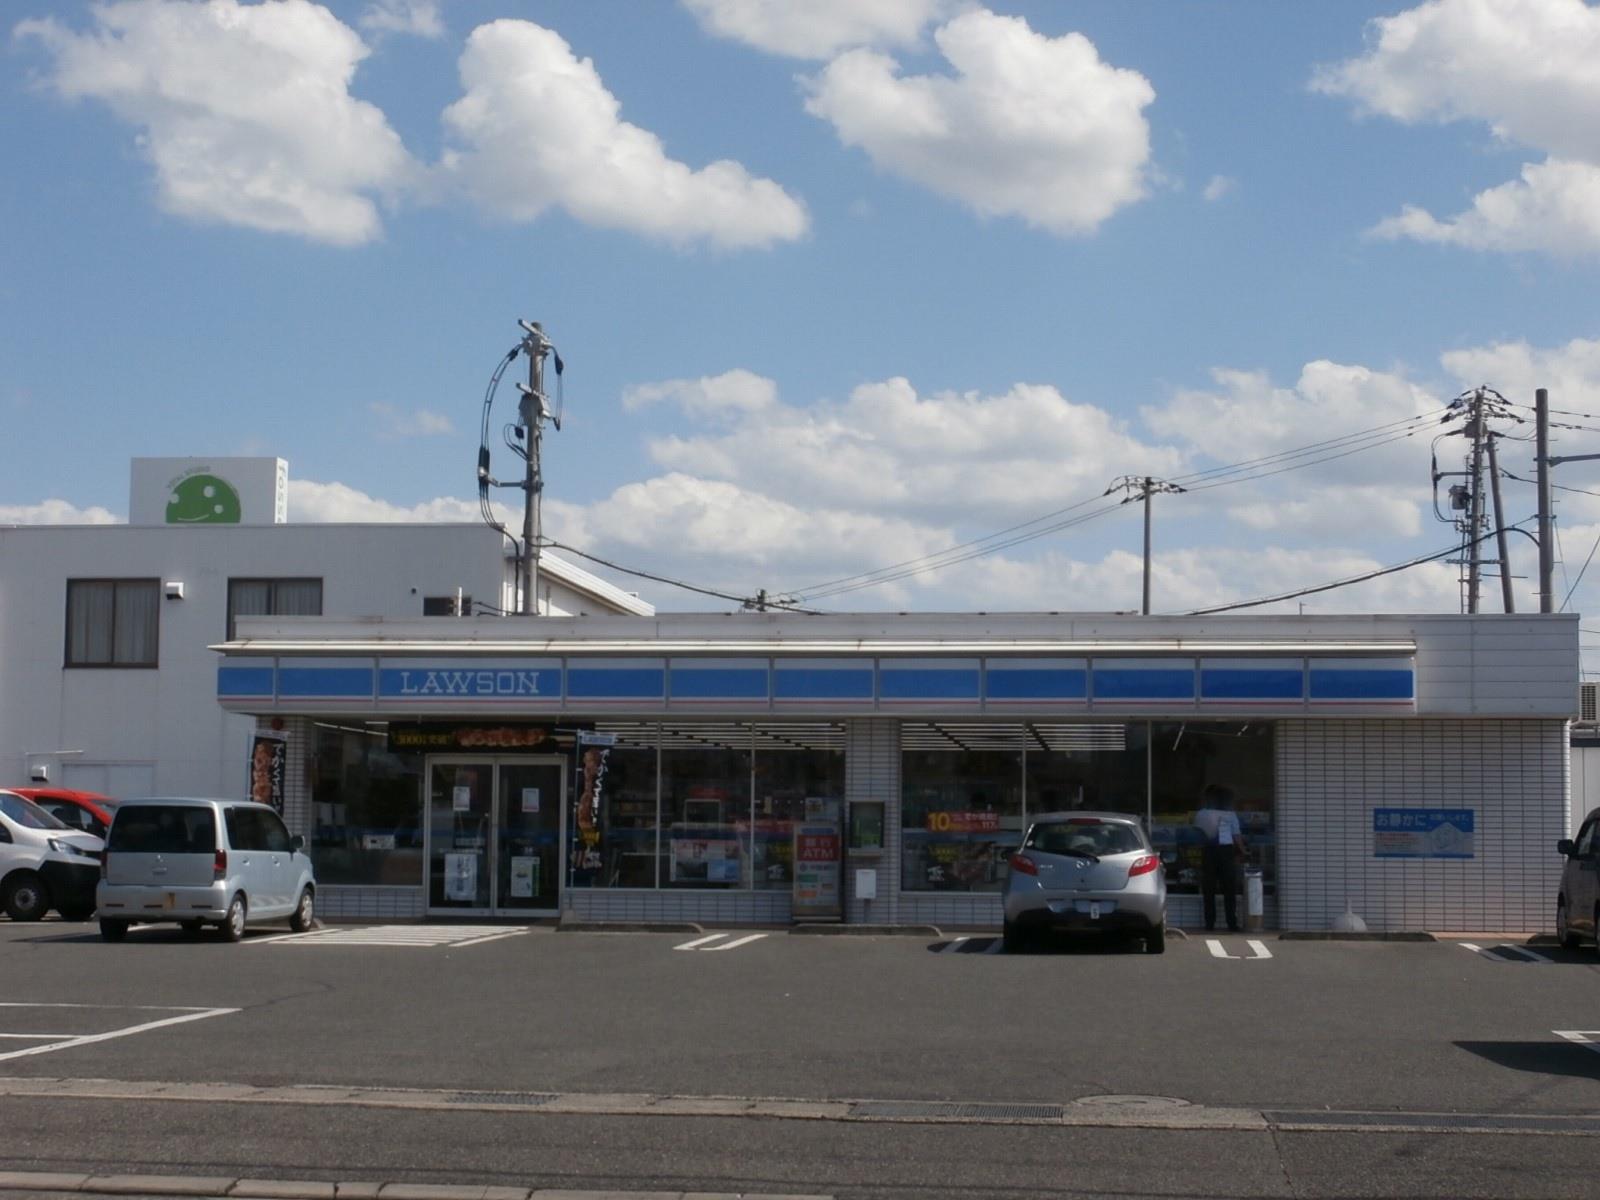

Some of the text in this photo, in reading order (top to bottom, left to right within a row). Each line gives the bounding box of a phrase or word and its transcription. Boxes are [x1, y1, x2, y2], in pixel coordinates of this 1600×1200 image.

[400, 671, 540, 694] LAWSON
[928, 812, 950, 831] 10
[803, 848, 834, 859] ATM
